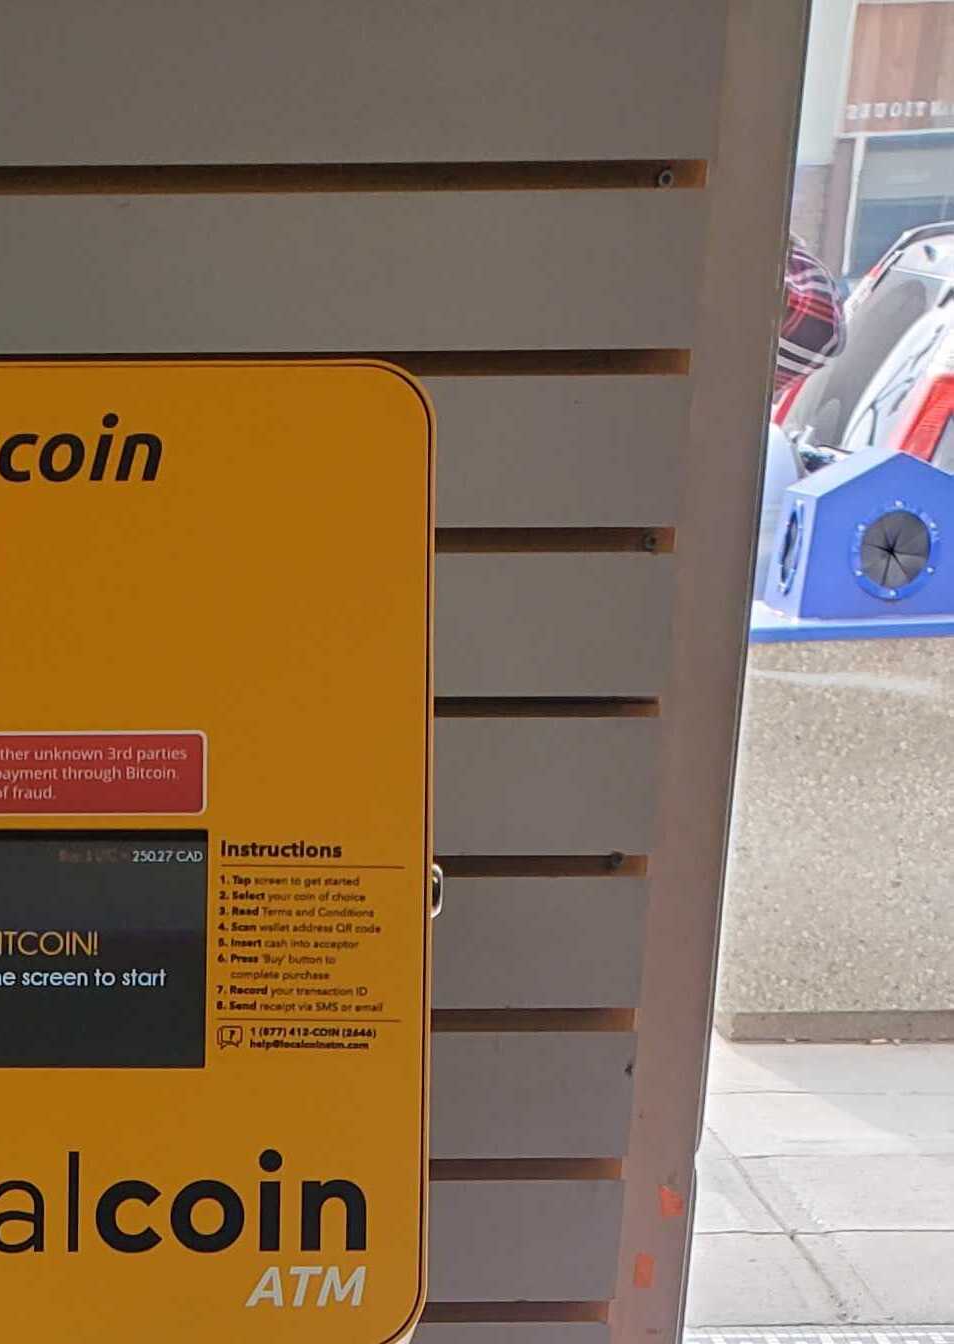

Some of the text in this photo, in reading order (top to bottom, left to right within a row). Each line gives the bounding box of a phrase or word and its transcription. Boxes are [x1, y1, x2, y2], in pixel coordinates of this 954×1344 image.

[34, 747, 103, 761] unknown
[107, 747, 133, 761] 3rd
[136, 747, 188, 765] parties
[62, 767, 122, 783] through
[125, 766, 180, 781] Bitcoin.
[13, 785, 57, 800] fraud.
[220, 840, 343, 858] Instructions
[176, 850, 204, 862] CAD
[232, 875, 251, 887] Tap
[254, 877, 288, 886] screen
[290, 876, 301, 885] to
[304, 877, 321, 888] get
[324, 876, 360, 886] started
[232, 890, 266, 900] Select
[268, 893, 292, 902] your
[294, 892, 316, 901] coin
[318, 892, 329, 901] of
[332, 892, 366, 902] choice
[231, 906, 259, 916] Read
[261, 907, 293, 917] Terms
[295, 907, 315, 917] and
[317, 907, 375, 918] Conditions
[231, 922, 257, 932] Scan
[260, 923, 290, 933] wallet
[292, 923, 333, 933] address
[335, 924, 353, 933] QR
[355, 924, 382, 934] code
[231, 938, 263, 948] Insert
[264, 939, 288, 948] cash
[291, 939, 311, 948] into
[313, 939, 359, 950] acceptor
[230, 954, 259, 964] Press
[288, 955, 323, 965] button
[325, 955, 336, 965] to
[22, 973, 89, 988] screen
[94, 968, 116, 987] to
[121, 968, 167, 987] start
[230, 970, 330, 981] complete purchase
[229, 985, 268, 995] Record
[270, 988, 294, 998] your
[296, 986, 354, 996] transaction
[356, 986, 368, 996] ID
[229, 1001, 257, 1010] Send
[260, 1002, 296, 1012] receipt
[299, 1002, 313, 1011] via
[315, 1002, 338, 1012] SMS
[341, 1004, 353, 1012] or
[355, 1003, 383, 1012] email
[245, 1265, 368, 1309] ATM
